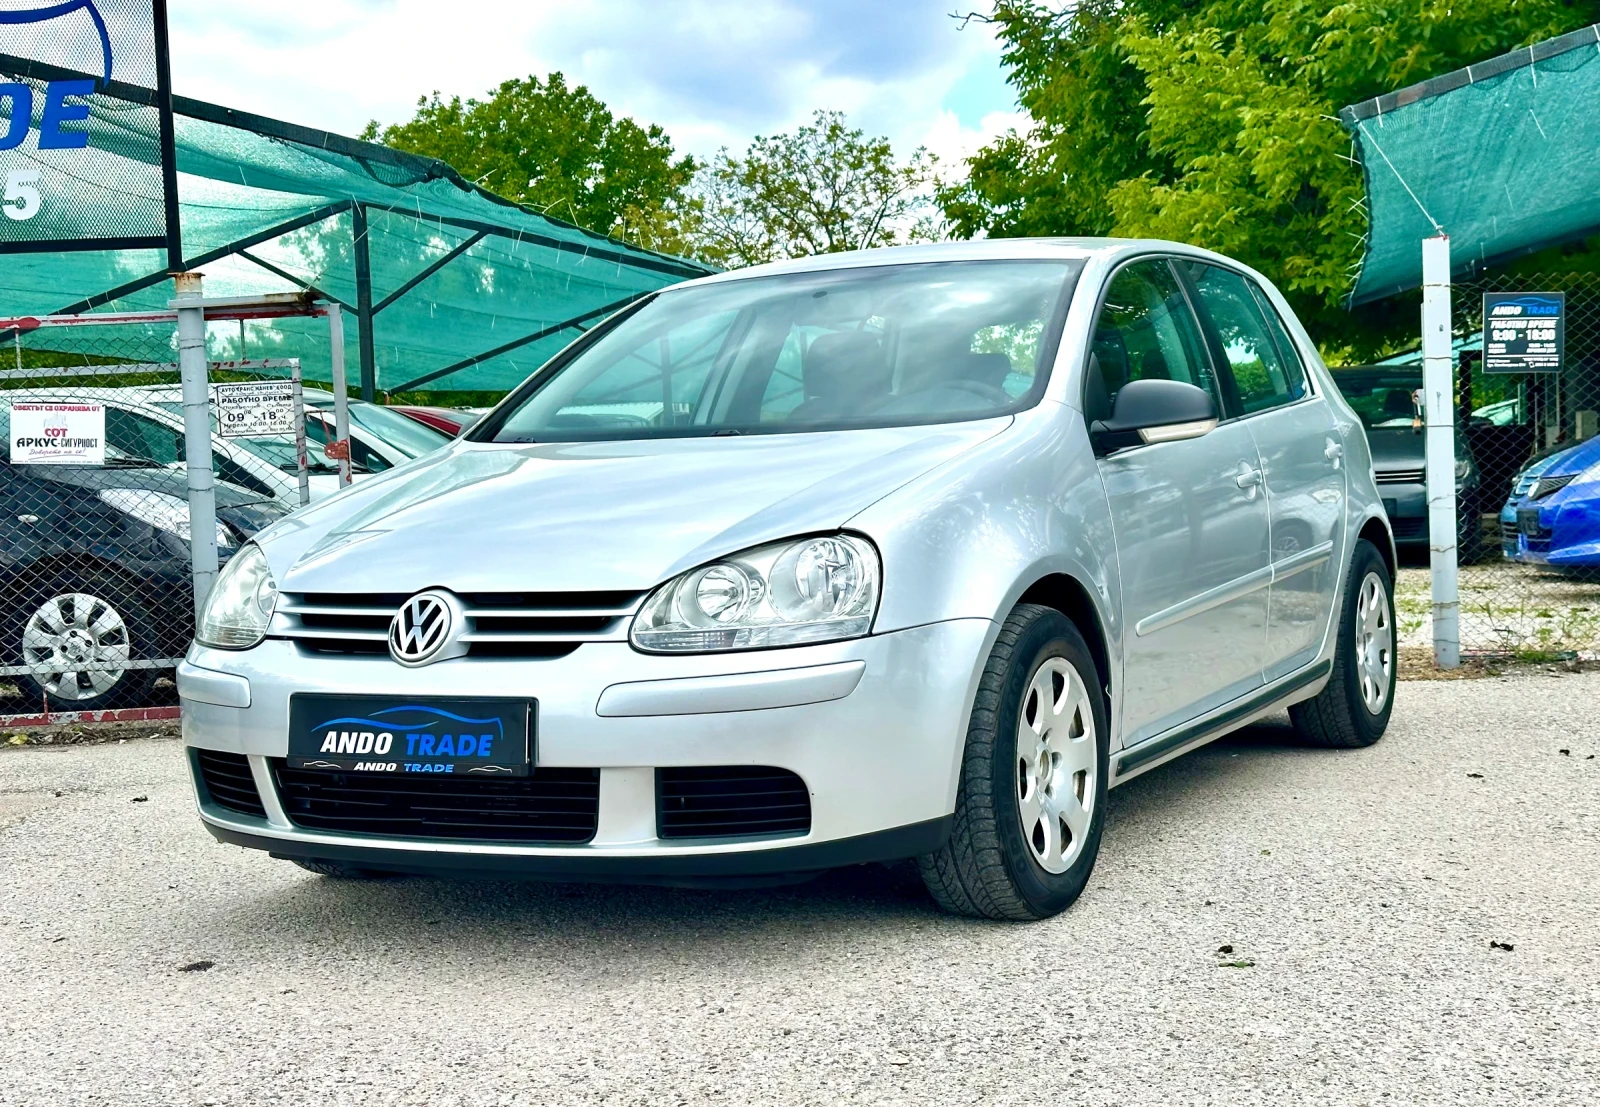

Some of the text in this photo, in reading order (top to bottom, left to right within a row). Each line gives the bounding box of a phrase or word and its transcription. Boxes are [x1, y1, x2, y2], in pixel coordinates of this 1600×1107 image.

[1491, 306, 1558, 315] ANDO TRADE
[1492, 329, 1516, 341] 9:00
[1525, 329, 1556, 341] 18:00
[221, 396, 261, 404] РАБОТНО
[44, 428, 68, 437] СОТ
[319, 730, 494, 757] ANDO TRADE
[353, 762, 454, 773] ANDO TRADE
